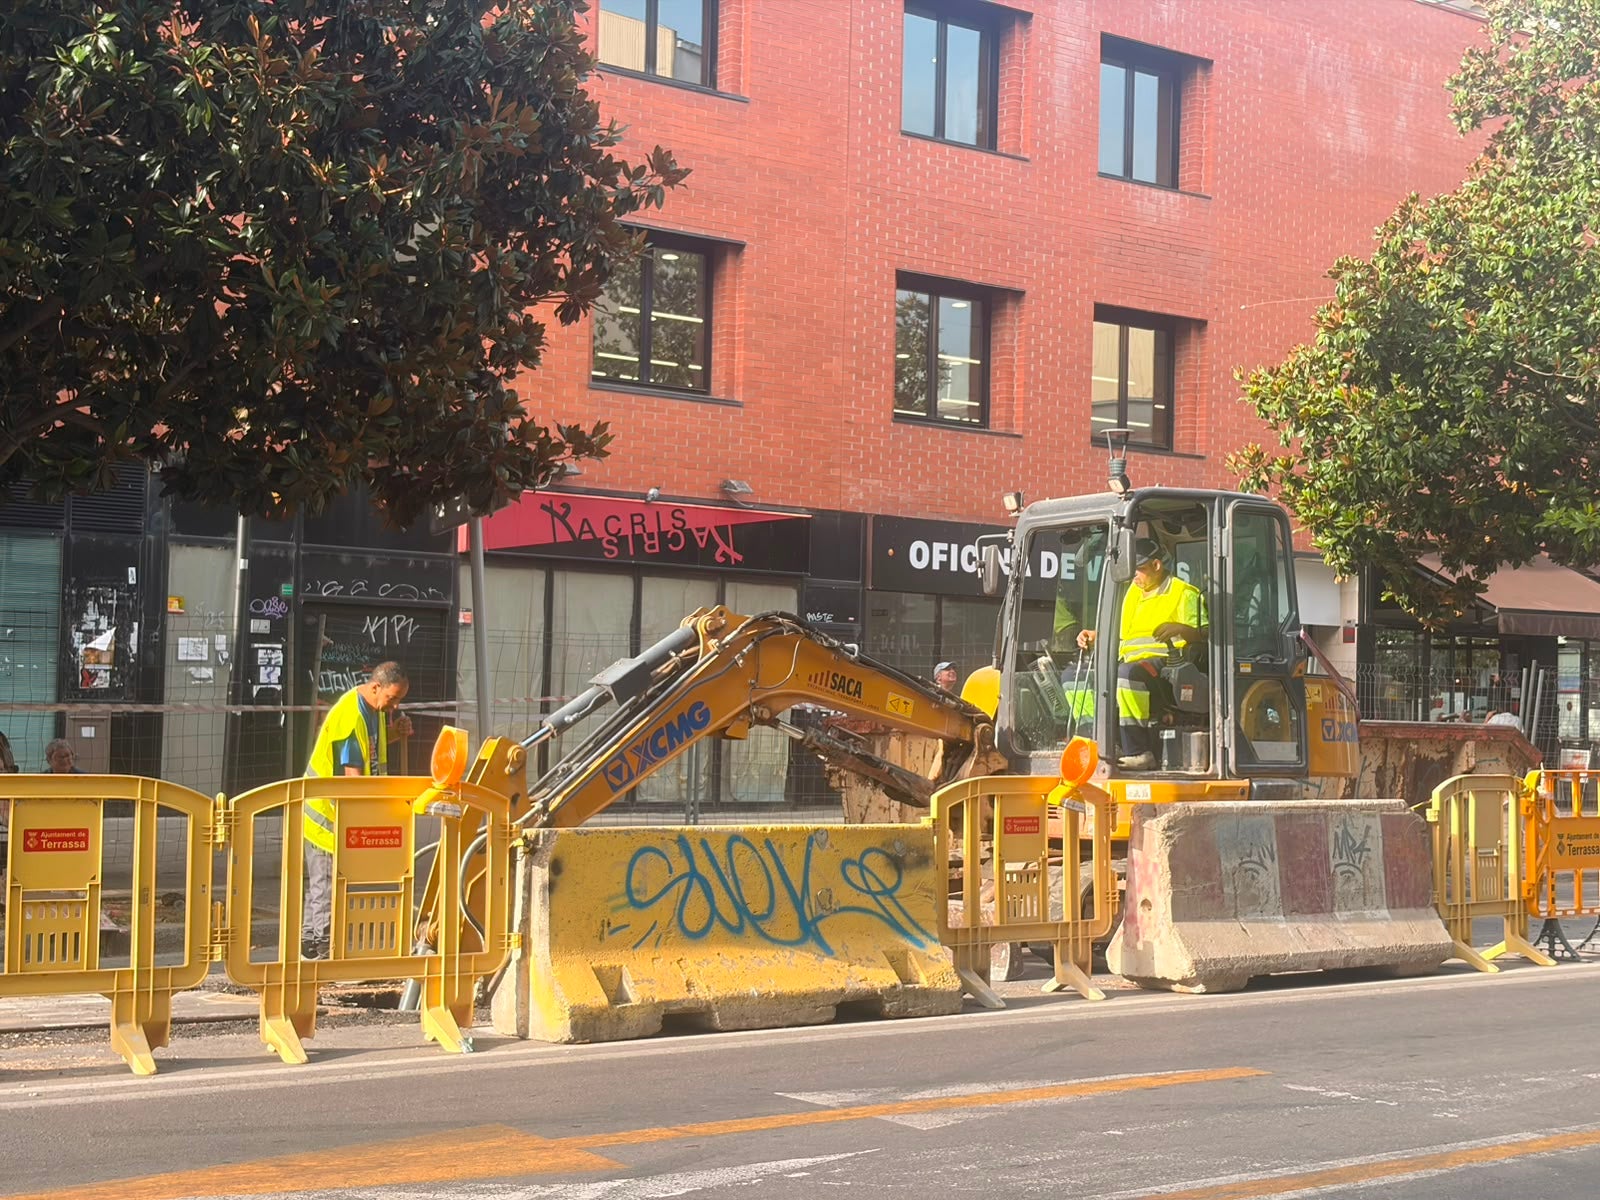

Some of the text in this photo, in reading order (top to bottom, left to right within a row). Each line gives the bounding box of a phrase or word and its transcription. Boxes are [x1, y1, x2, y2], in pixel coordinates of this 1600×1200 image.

[540, 500, 687, 543] KACRIS
[1040, 551, 1076, 580] DE
[830, 672, 863, 699] SACA
[630, 700, 712, 777] XCMG
[41, 839, 86, 849] Terrassa
[361, 836, 400, 846] Terrassa
[1567, 843, 1600, 856] Terrassa
